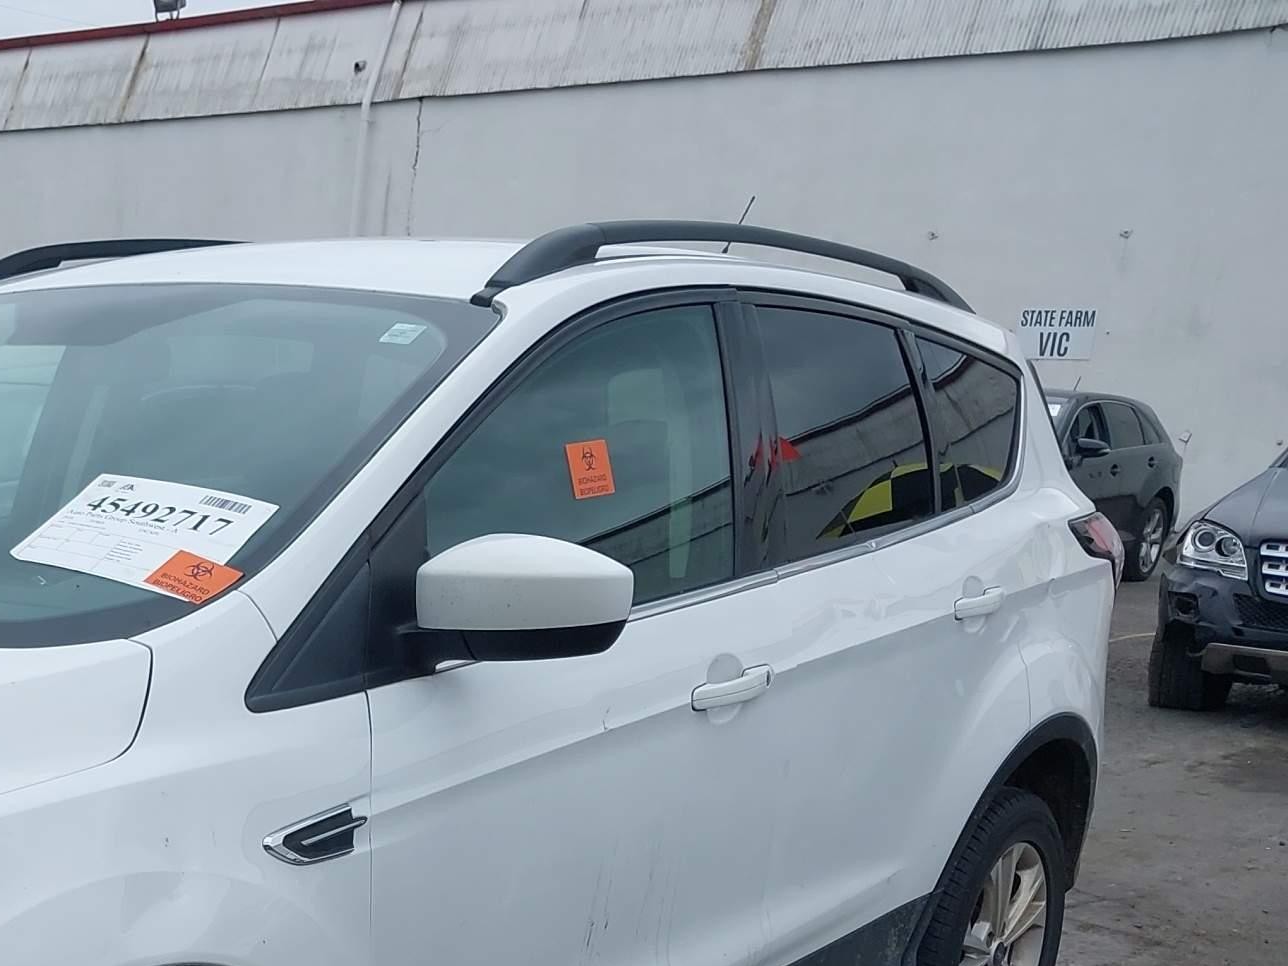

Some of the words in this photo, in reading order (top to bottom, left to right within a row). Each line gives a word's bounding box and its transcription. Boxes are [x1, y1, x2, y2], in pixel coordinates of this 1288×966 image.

[1021, 310, 1056, 327] STATE
[1058, 310, 1096, 327] FARM
[1039, 332, 1070, 357] VIC
[86, 496, 235, 536] 45492717
[152, 578, 203, 602] BIOPELIGRO
[160, 572, 210, 596] BIOHAZARD
